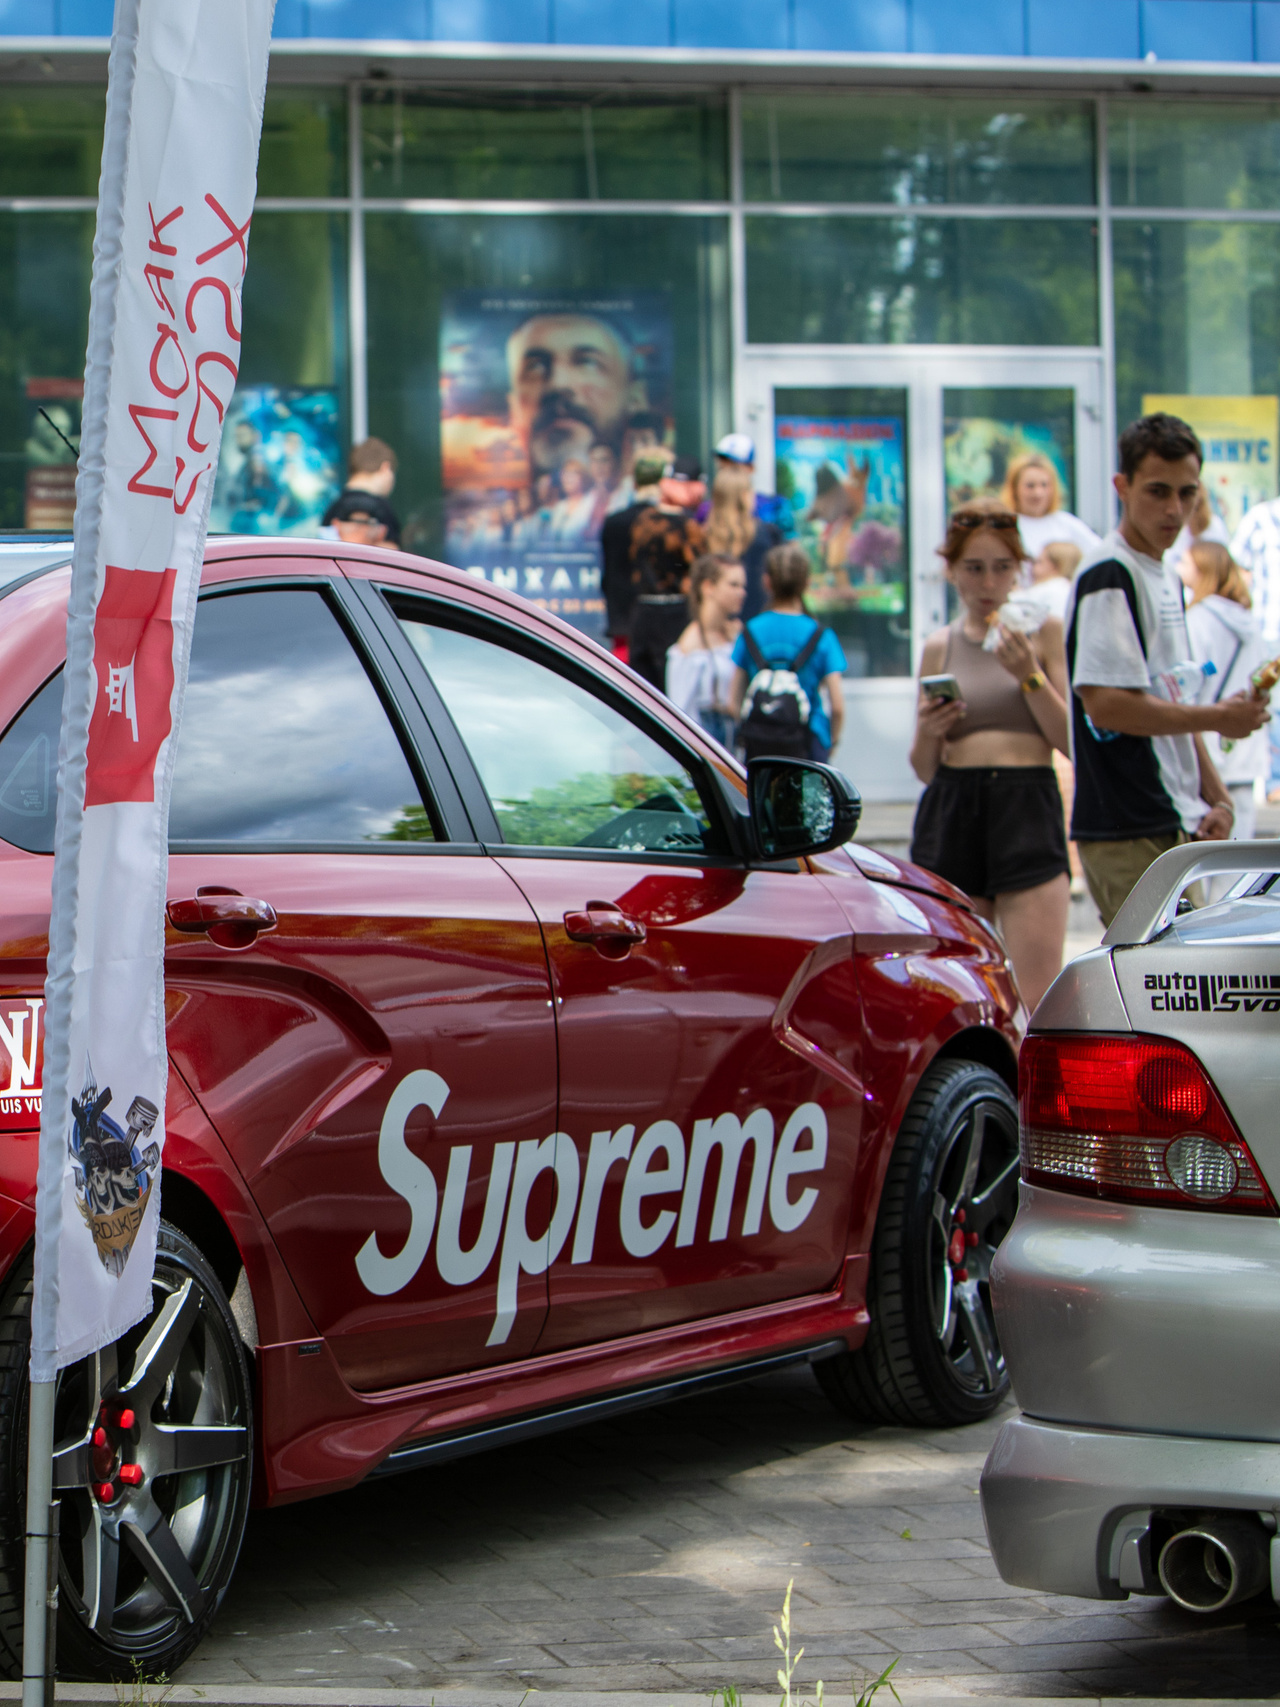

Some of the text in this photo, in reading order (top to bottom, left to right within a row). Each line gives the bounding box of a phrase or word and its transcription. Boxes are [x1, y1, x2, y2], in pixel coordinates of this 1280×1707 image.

[1144, 972, 1198, 991] auto
[1151, 991, 1199, 1012] club
[25, 1098, 42, 1114] VU
[354, 1068, 829, 1348] Supreme
